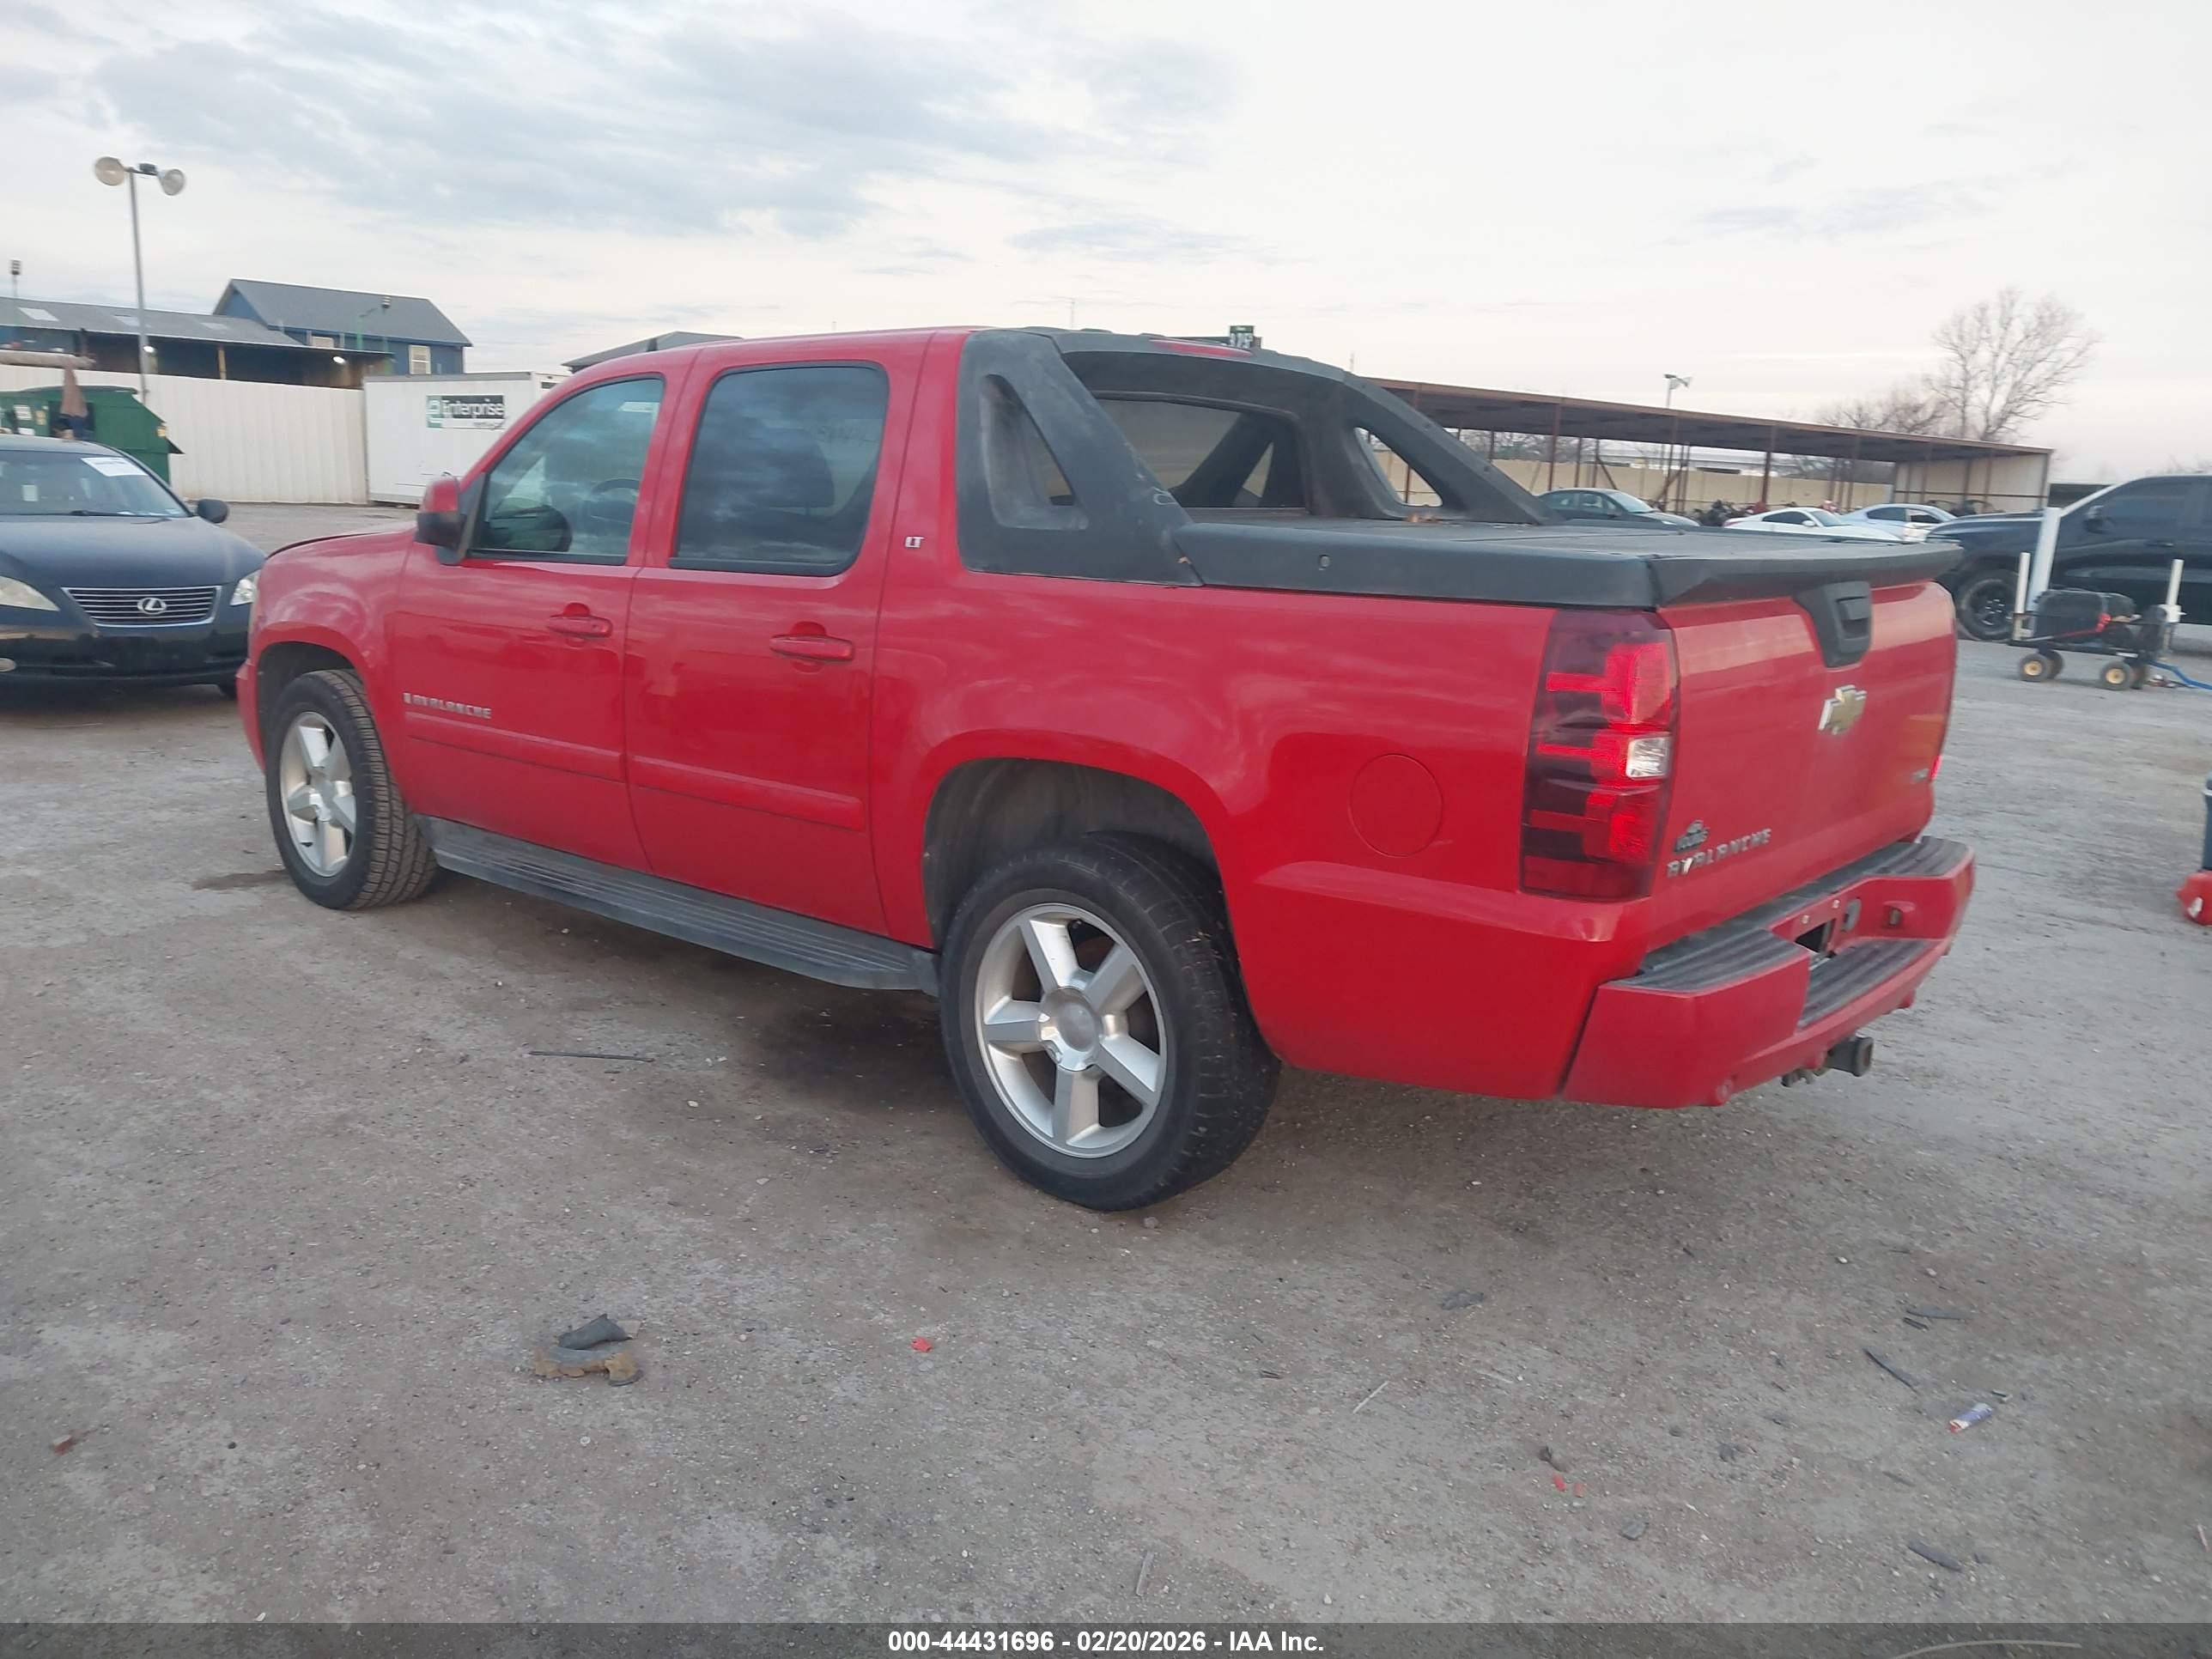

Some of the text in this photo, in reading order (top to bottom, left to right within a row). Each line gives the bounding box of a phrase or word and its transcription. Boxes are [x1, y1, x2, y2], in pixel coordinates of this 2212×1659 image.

[441, 398, 505, 418] Enterprise
[905, 536, 925, 548] LT
[1667, 828, 1771, 878] AVALANCHE
